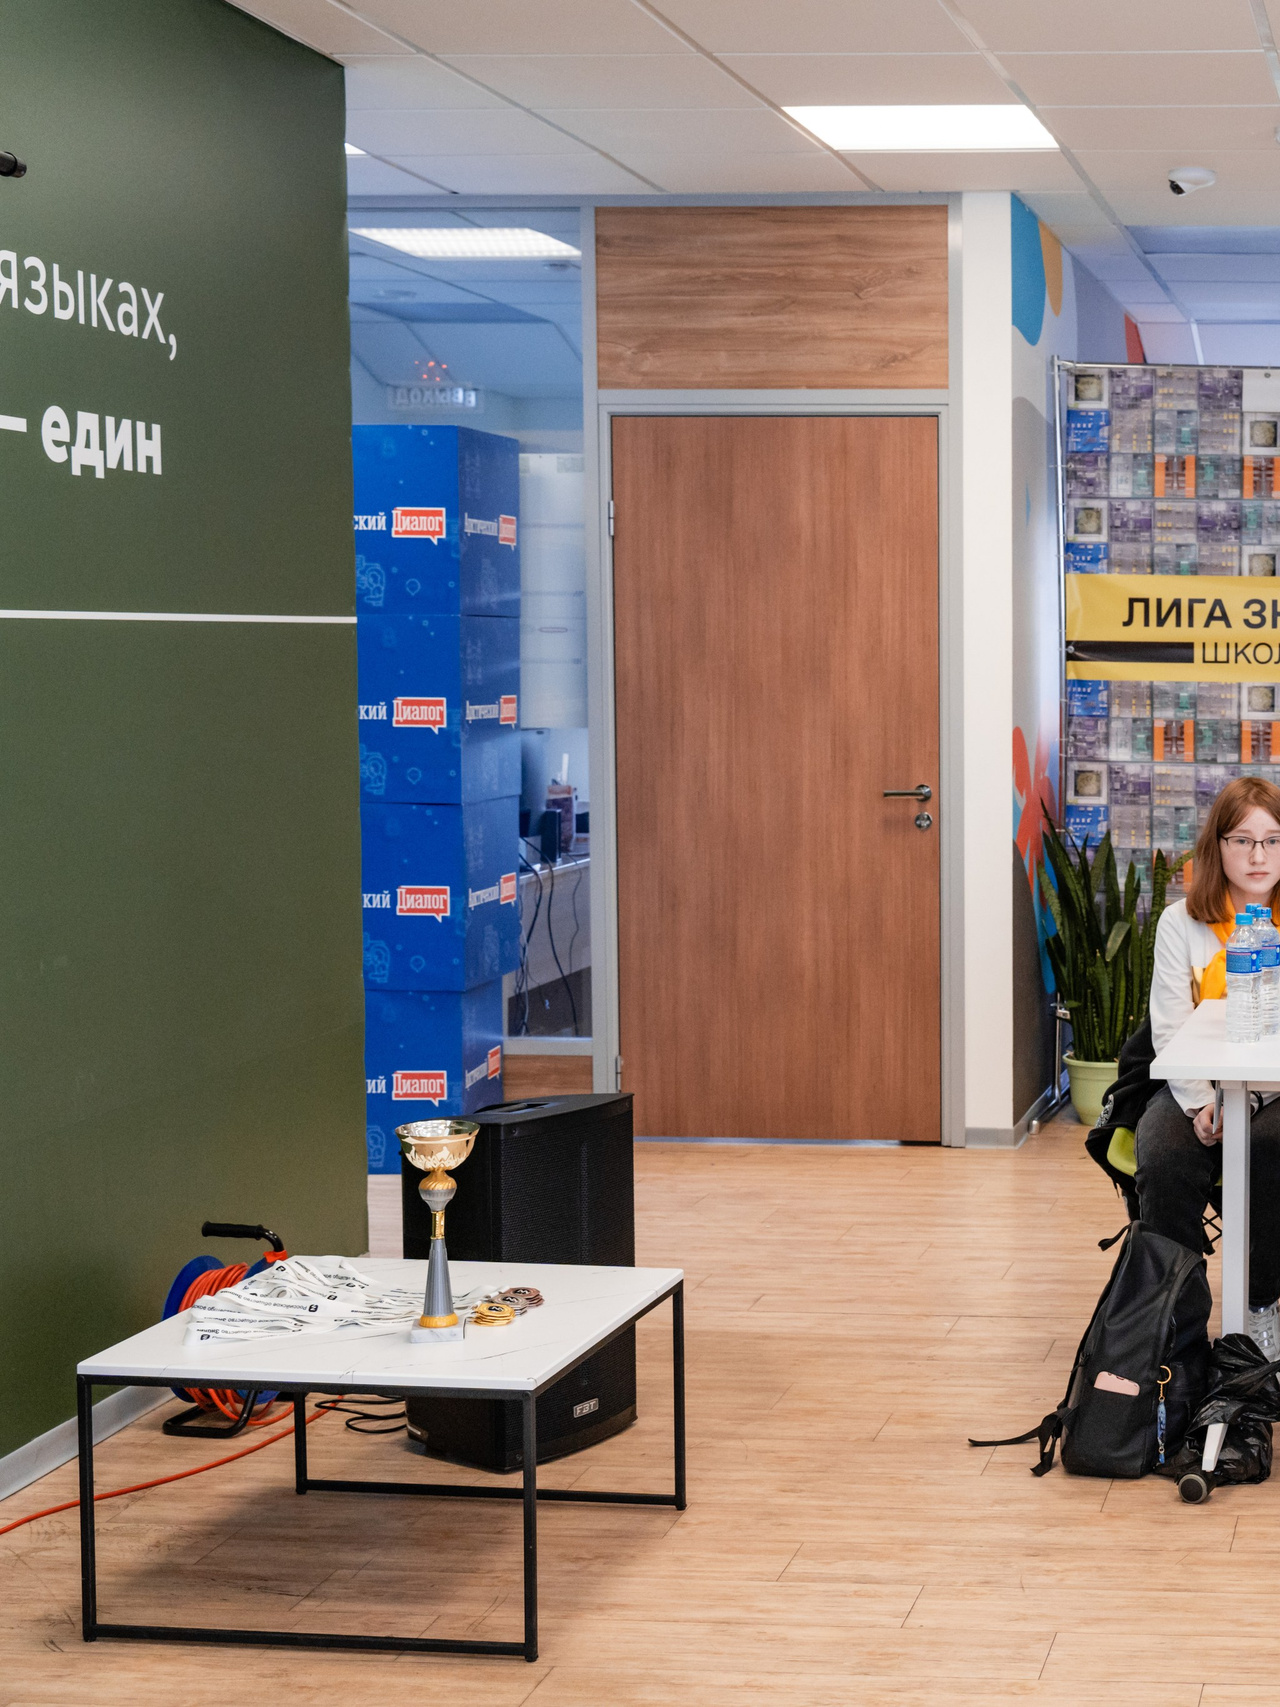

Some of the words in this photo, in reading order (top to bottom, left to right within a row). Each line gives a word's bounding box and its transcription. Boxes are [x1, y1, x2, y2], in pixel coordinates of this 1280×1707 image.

[0, 249, 177, 361] языках,
[41, 405, 162, 479] един
[392, 510, 443, 533] Диалог
[1122, 597, 1232, 629] ЛИГА
[393, 699, 444, 722] Диалог
[396, 888, 448, 911] Диалог
[392, 1073, 444, 1096] Диалог
[576, 1400, 597, 1416] FBT
